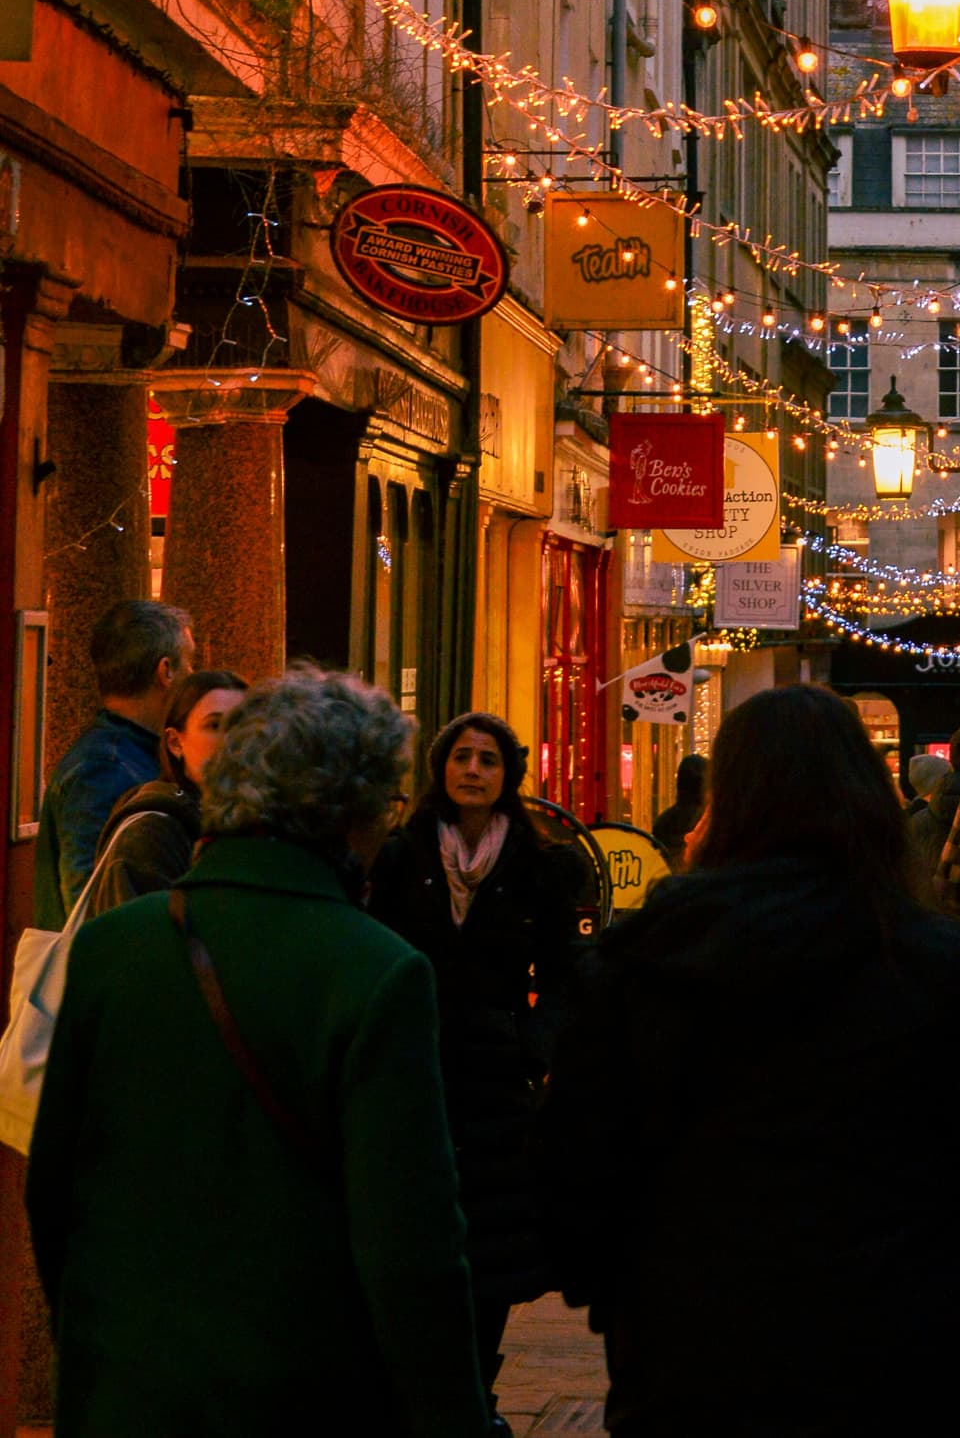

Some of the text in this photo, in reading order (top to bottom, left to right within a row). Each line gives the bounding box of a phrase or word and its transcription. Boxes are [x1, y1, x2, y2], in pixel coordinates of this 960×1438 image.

[380, 197, 475, 243] CORNISH
[360, 244, 474, 278] CORNISH PASTIES
[366, 234, 473, 268] AWARD WINNING
[353, 259, 466, 311] BAKEHOUSE
[649, 459, 693, 479] Ben's
[650, 476, 708, 497] Cookies
[725, 490, 774, 503] Action
[694, 525, 739, 539] SHOP
[744, 562, 772, 574] THE
[732, 579, 782, 592] SILVER
[738, 597, 776, 609] SHOP
